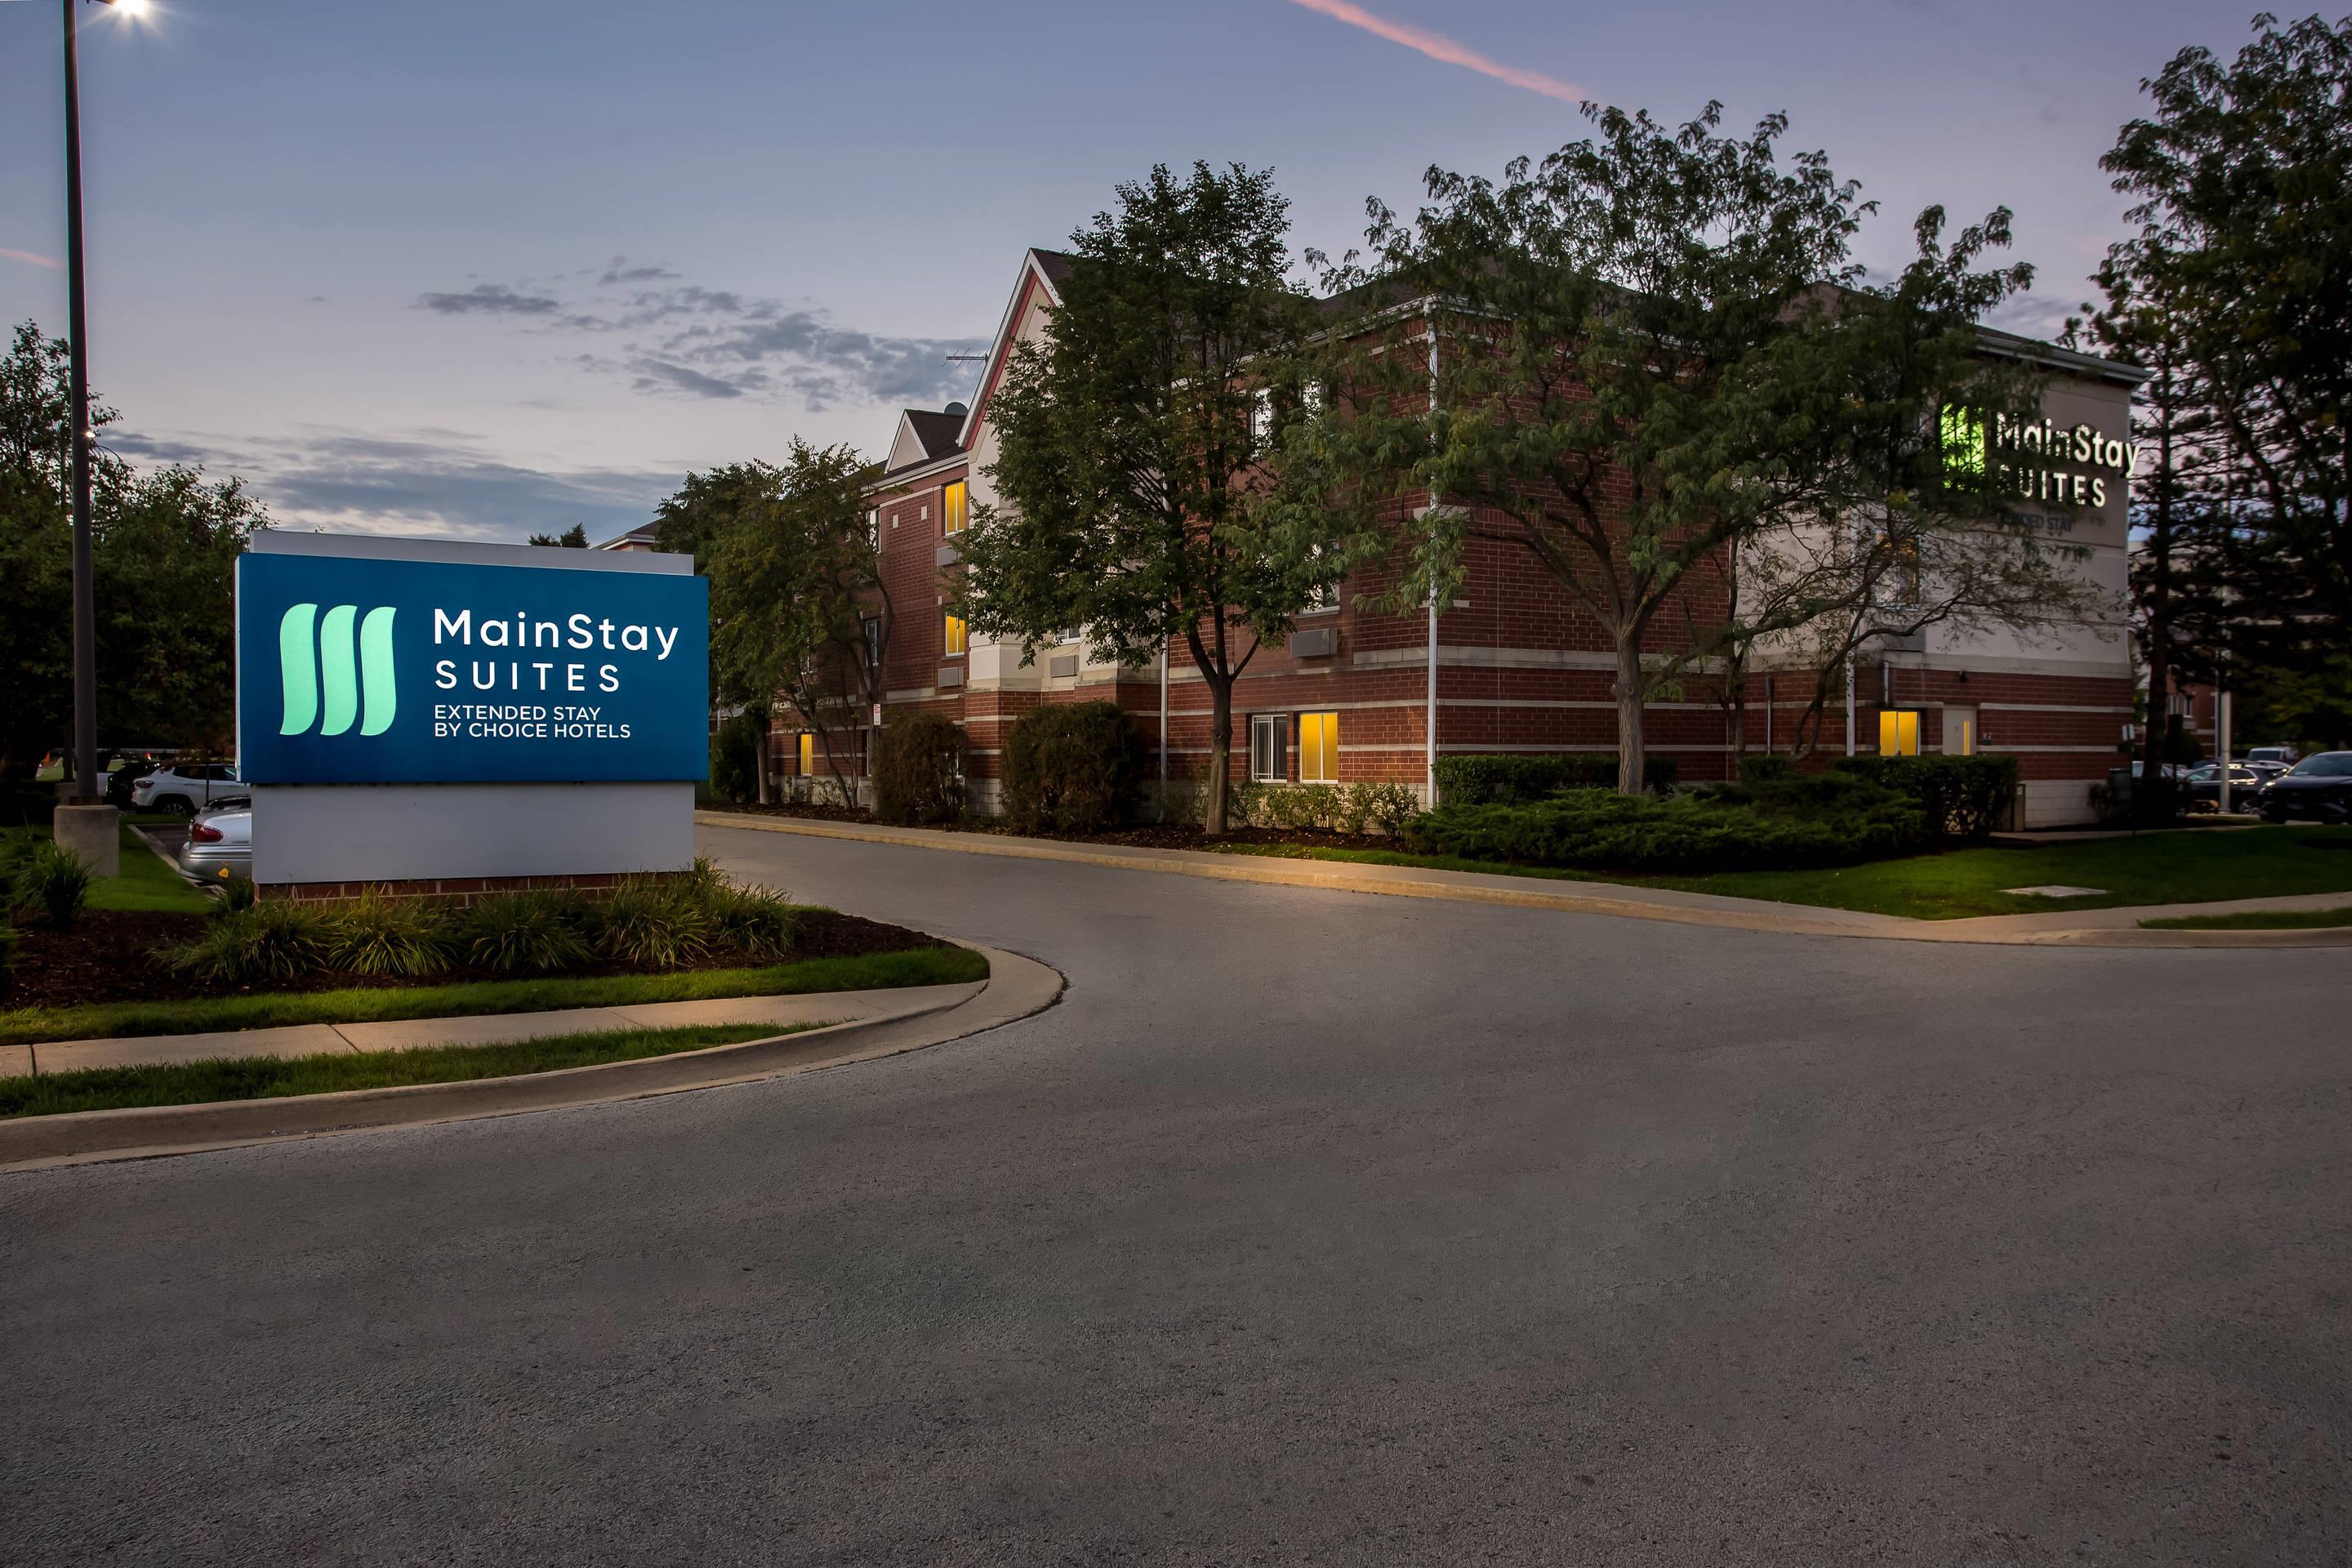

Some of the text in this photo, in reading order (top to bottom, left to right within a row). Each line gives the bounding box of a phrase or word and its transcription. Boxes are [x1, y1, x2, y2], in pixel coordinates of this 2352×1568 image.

[1996, 412, 2140, 478] MainStay
[434, 608, 679, 660] MainStay
[434, 660, 620, 693] SUITES
[434, 705, 602, 721] EXTENDED STAY
[434, 723, 630, 738] BY CHOICE HOTELS
